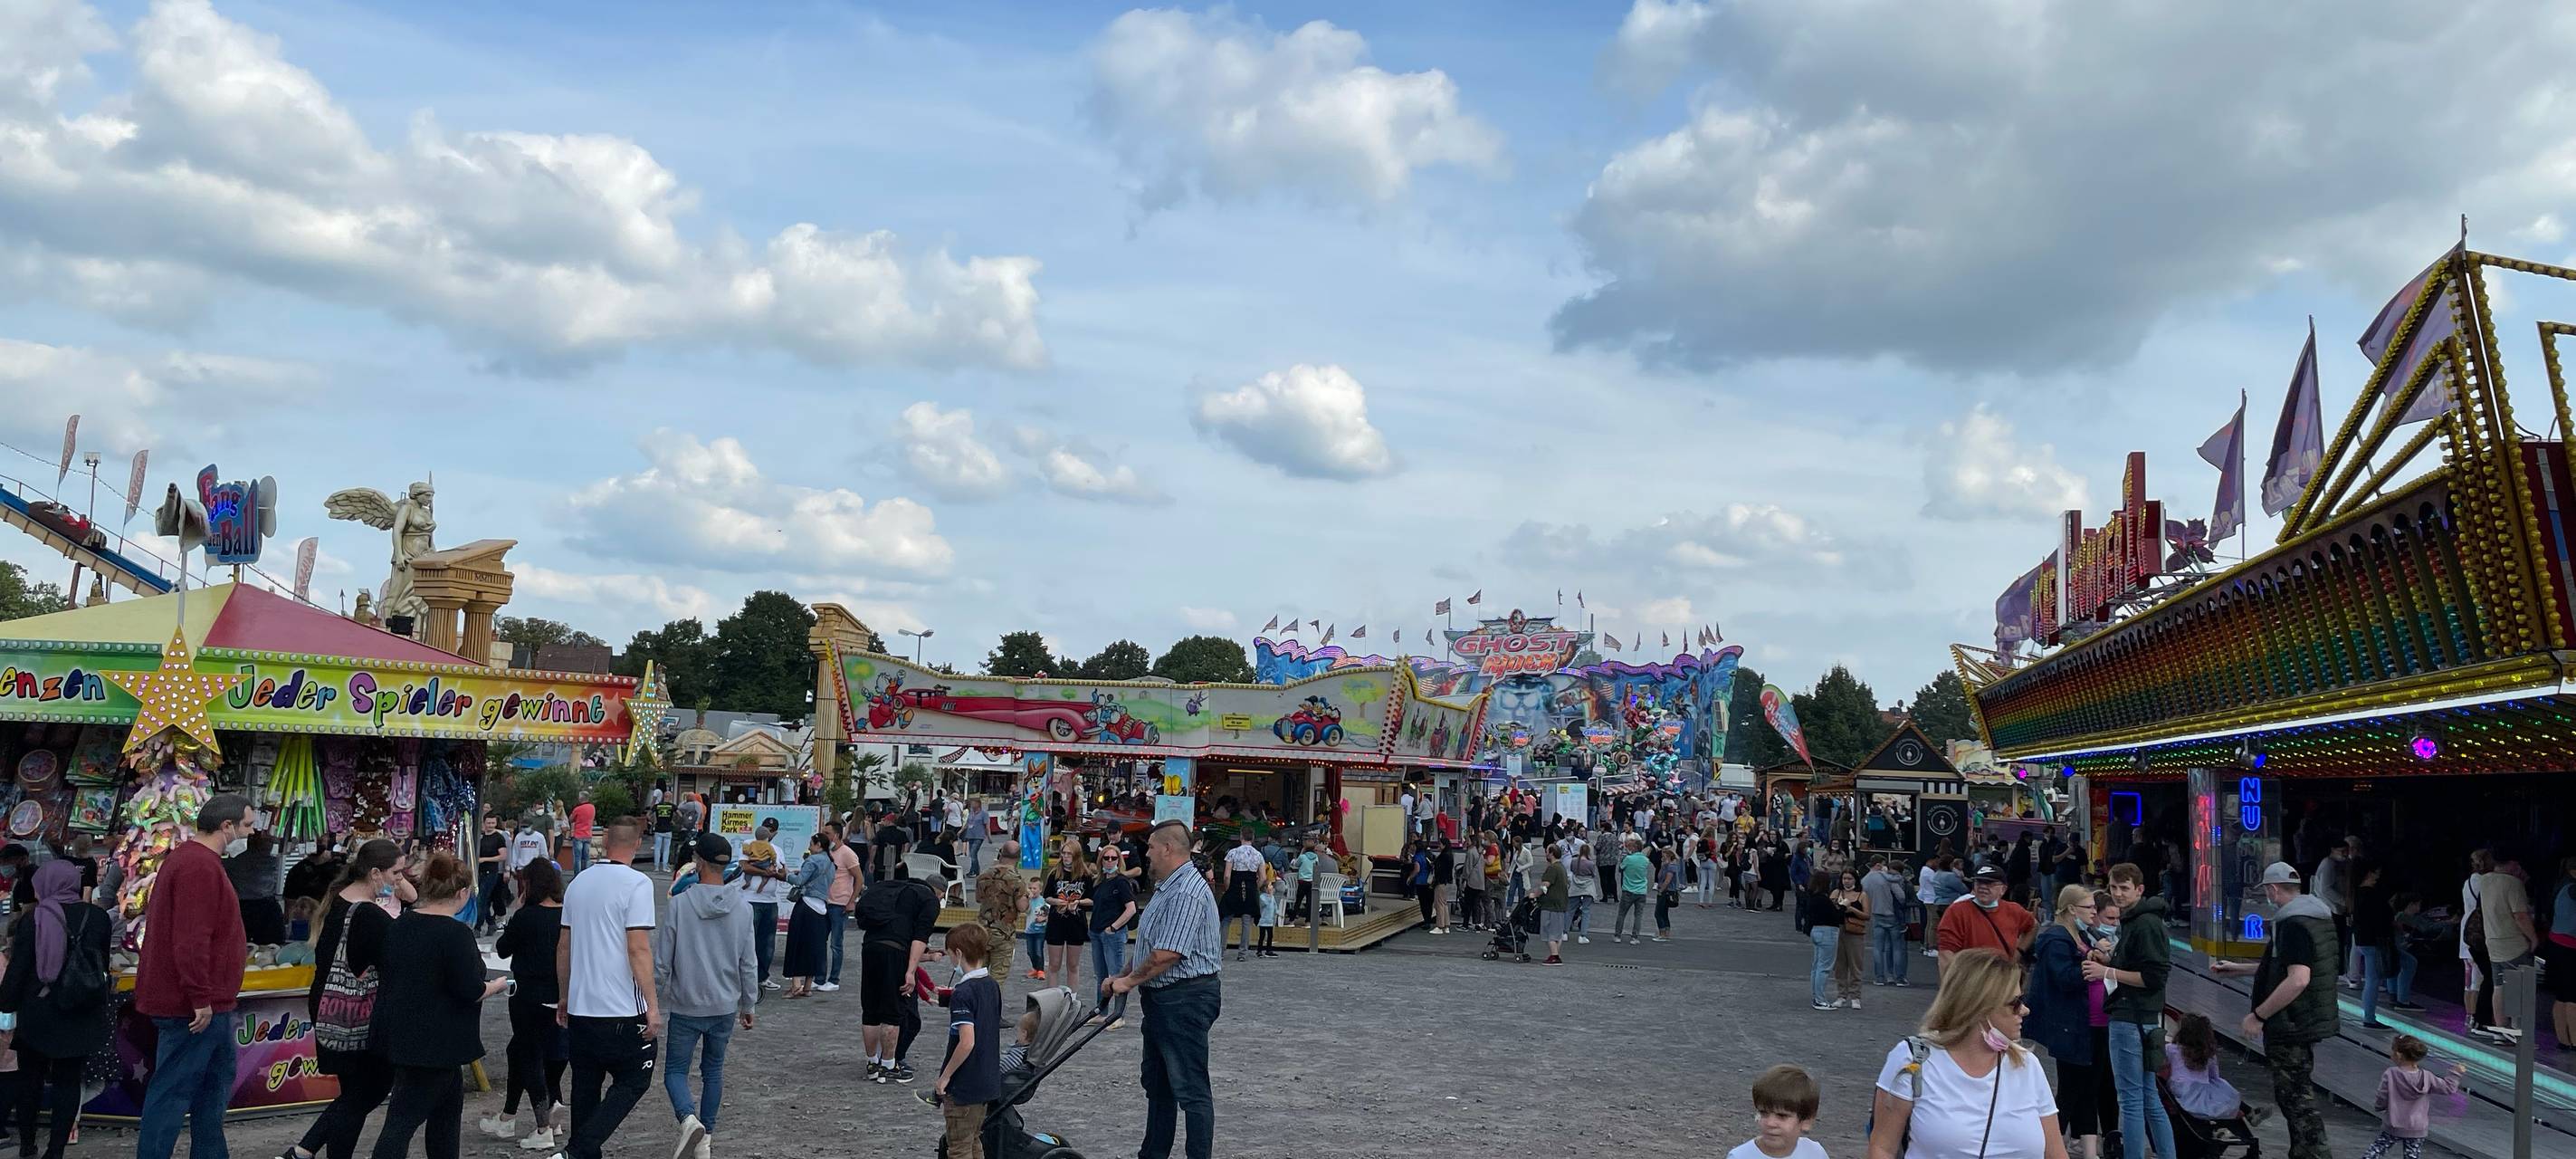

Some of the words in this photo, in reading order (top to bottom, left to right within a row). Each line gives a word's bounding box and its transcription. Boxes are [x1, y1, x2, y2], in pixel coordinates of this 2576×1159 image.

[220, 491, 256, 556] Ball
[1454, 632, 1577, 654] GHOST
[1482, 652, 1559, 679] RIDER
[228, 665, 337, 711] Jeder
[349, 672, 473, 728] Spieler
[479, 693, 606, 731] gewinnt
[721, 810, 753, 819] Hammer
[721, 818, 749, 827] Kirmes
[720, 825, 738, 833] Park
[237, 1011, 312, 1045] Jeder
